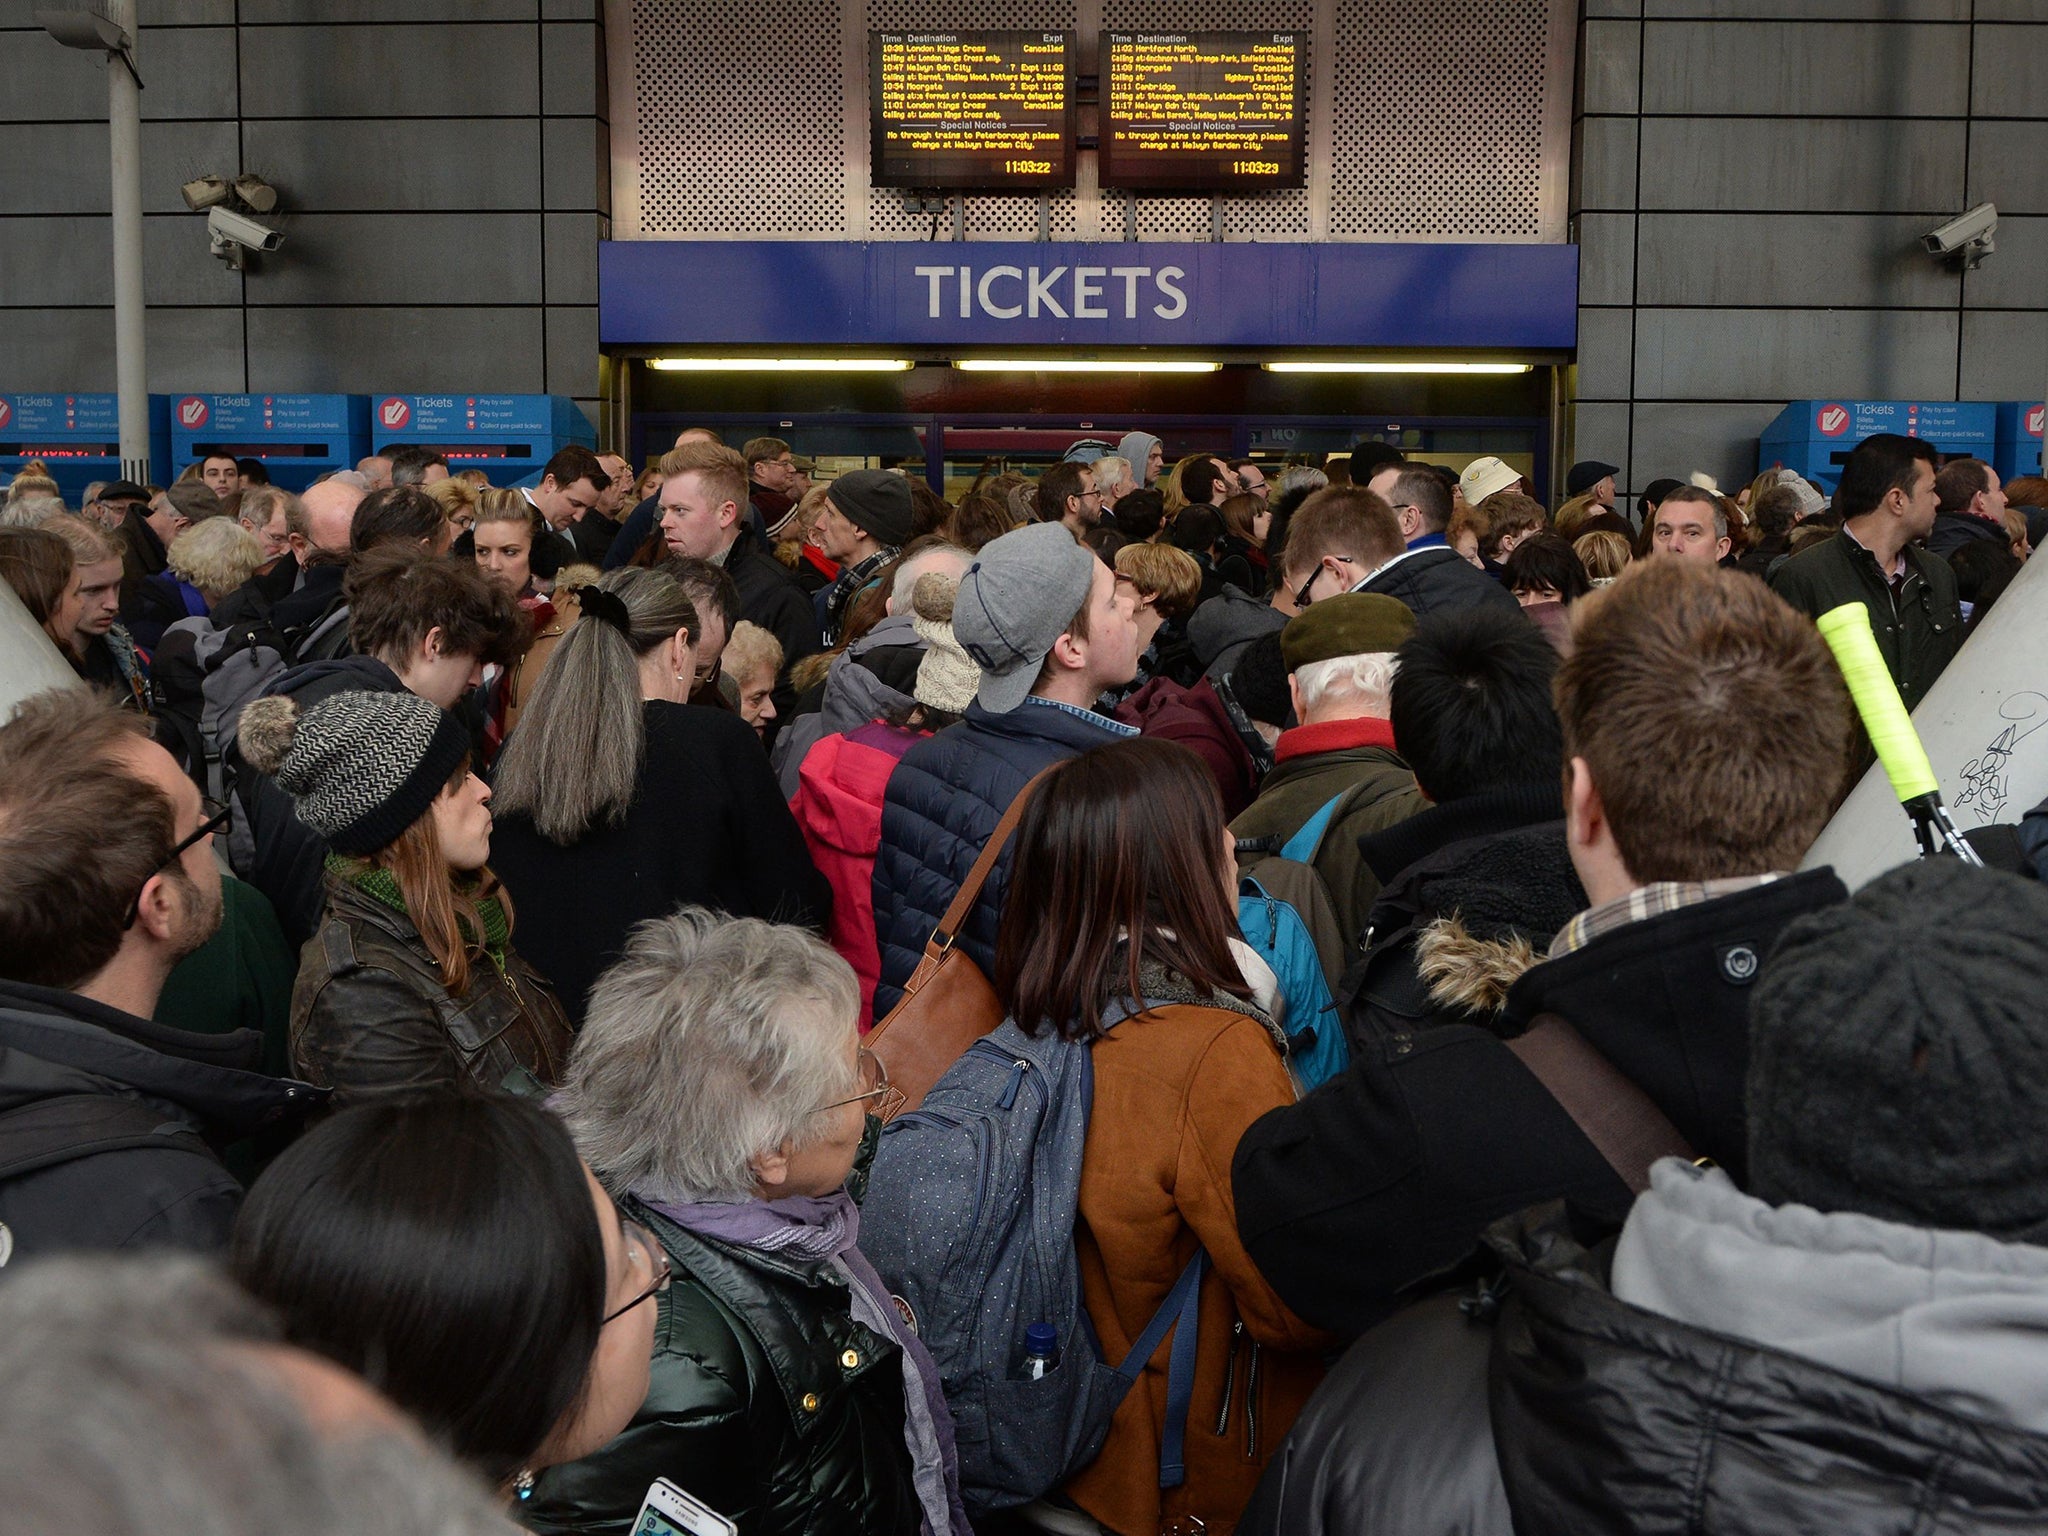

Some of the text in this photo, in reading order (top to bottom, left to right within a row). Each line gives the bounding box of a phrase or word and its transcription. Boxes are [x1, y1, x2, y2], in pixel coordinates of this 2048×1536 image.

[880, 34, 1063, 44] Time Destination Expt
[1110, 34, 1294, 44] Time Destination Expt
[906, 44, 935, 53] London
[937, 44, 960, 54] Kings
[963, 44, 987, 53] Cross
[1023, 44, 1065, 53] Cancelled
[1135, 44, 1172, 53] Hertford
[1174, 44, 1198, 53] North
[1253, 44, 1294, 53] Cancelled
[883, 54, 905, 63] Calling
[918, 54, 942, 62] London
[944, 54, 962, 63] Kings
[963, 54, 984, 62] Cross
[1111, 54, 1134, 63] Calling
[954, 63, 972, 73] City
[1010, 63, 1016, 72] 7
[1020, 63, 1040, 73] Expt
[1135, 63, 1172, 73] Moorgate
[1252, 63, 1294, 72] Cancelled
[883, 73, 905, 82] Calling
[1111, 73, 1134, 82] Calling
[906, 82, 943, 91] Moorgate
[1010, 82, 1016, 91] 2
[1020, 82, 1040, 92] Expt
[1135, 83, 1177, 92] Cambridge
[1252, 83, 1293, 91] Cancelled
[883, 92, 905, 101] Calling
[1111, 92, 1134, 101] Calling
[906, 101, 935, 110] London
[937, 101, 960, 111] Kings
[963, 101, 987, 110] Cross
[1023, 101, 1064, 110] Cancelled
[1182, 101, 1201, 111] City
[1239, 101, 1245, 110] 7
[1261, 101, 1272, 110] On
[1275, 101, 1293, 110] time
[883, 111, 905, 120] Calling
[918, 111, 942, 119] London
[944, 111, 962, 120] Kings
[963, 111, 984, 119] Cross
[1111, 111, 1134, 121] Calling
[940, 121, 1007, 131] Special Notices
[1169, 122, 1236, 131] Special Notices
[887, 131, 1060, 141] No through trains to Peterborough please
[1115, 132, 1289, 142] No through trains to Peterborough please
[912, 141, 941, 150] change
[943, 141, 952, 149] at
[985, 141, 1013, 149] Garden
[1014, 141, 1035, 151] City.
[1140, 142, 1168, 151] change
[1171, 142, 1180, 150] at
[1213, 142, 1241, 150] Garden
[1243, 142, 1263, 151] City.
[1005, 160, 1051, 173] 11:03:22
[1233, 161, 1279, 174] 11:03:23
[915, 265, 1188, 320] TICKETS
[16, 396, 53, 407] Tickets
[213, 396, 250, 407] Tickets
[414, 397, 453, 408] Tickets
[1855, 404, 1895, 415] Tickets
